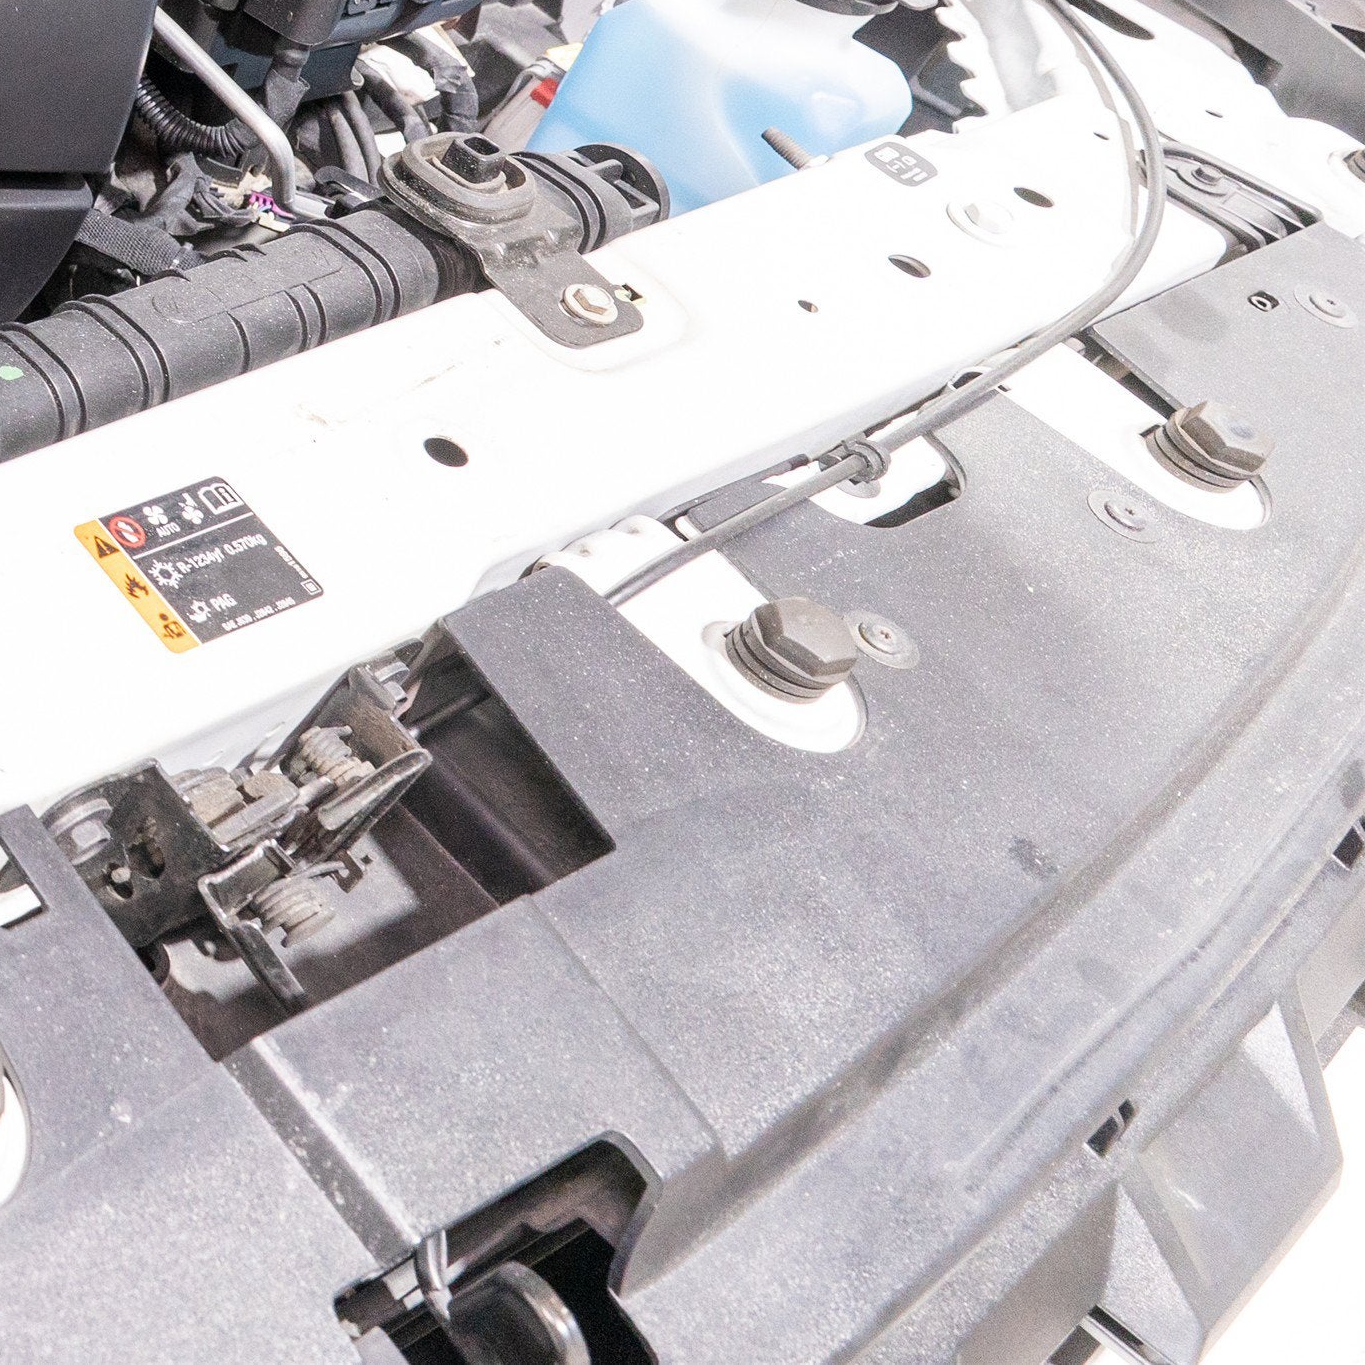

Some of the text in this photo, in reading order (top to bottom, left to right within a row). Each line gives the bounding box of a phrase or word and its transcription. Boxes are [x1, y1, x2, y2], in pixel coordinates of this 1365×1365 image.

[156, 522, 181, 537] AUTO
[176, 546, 226, 574] R-1234yf
[209, 593, 239, 613] PAG
